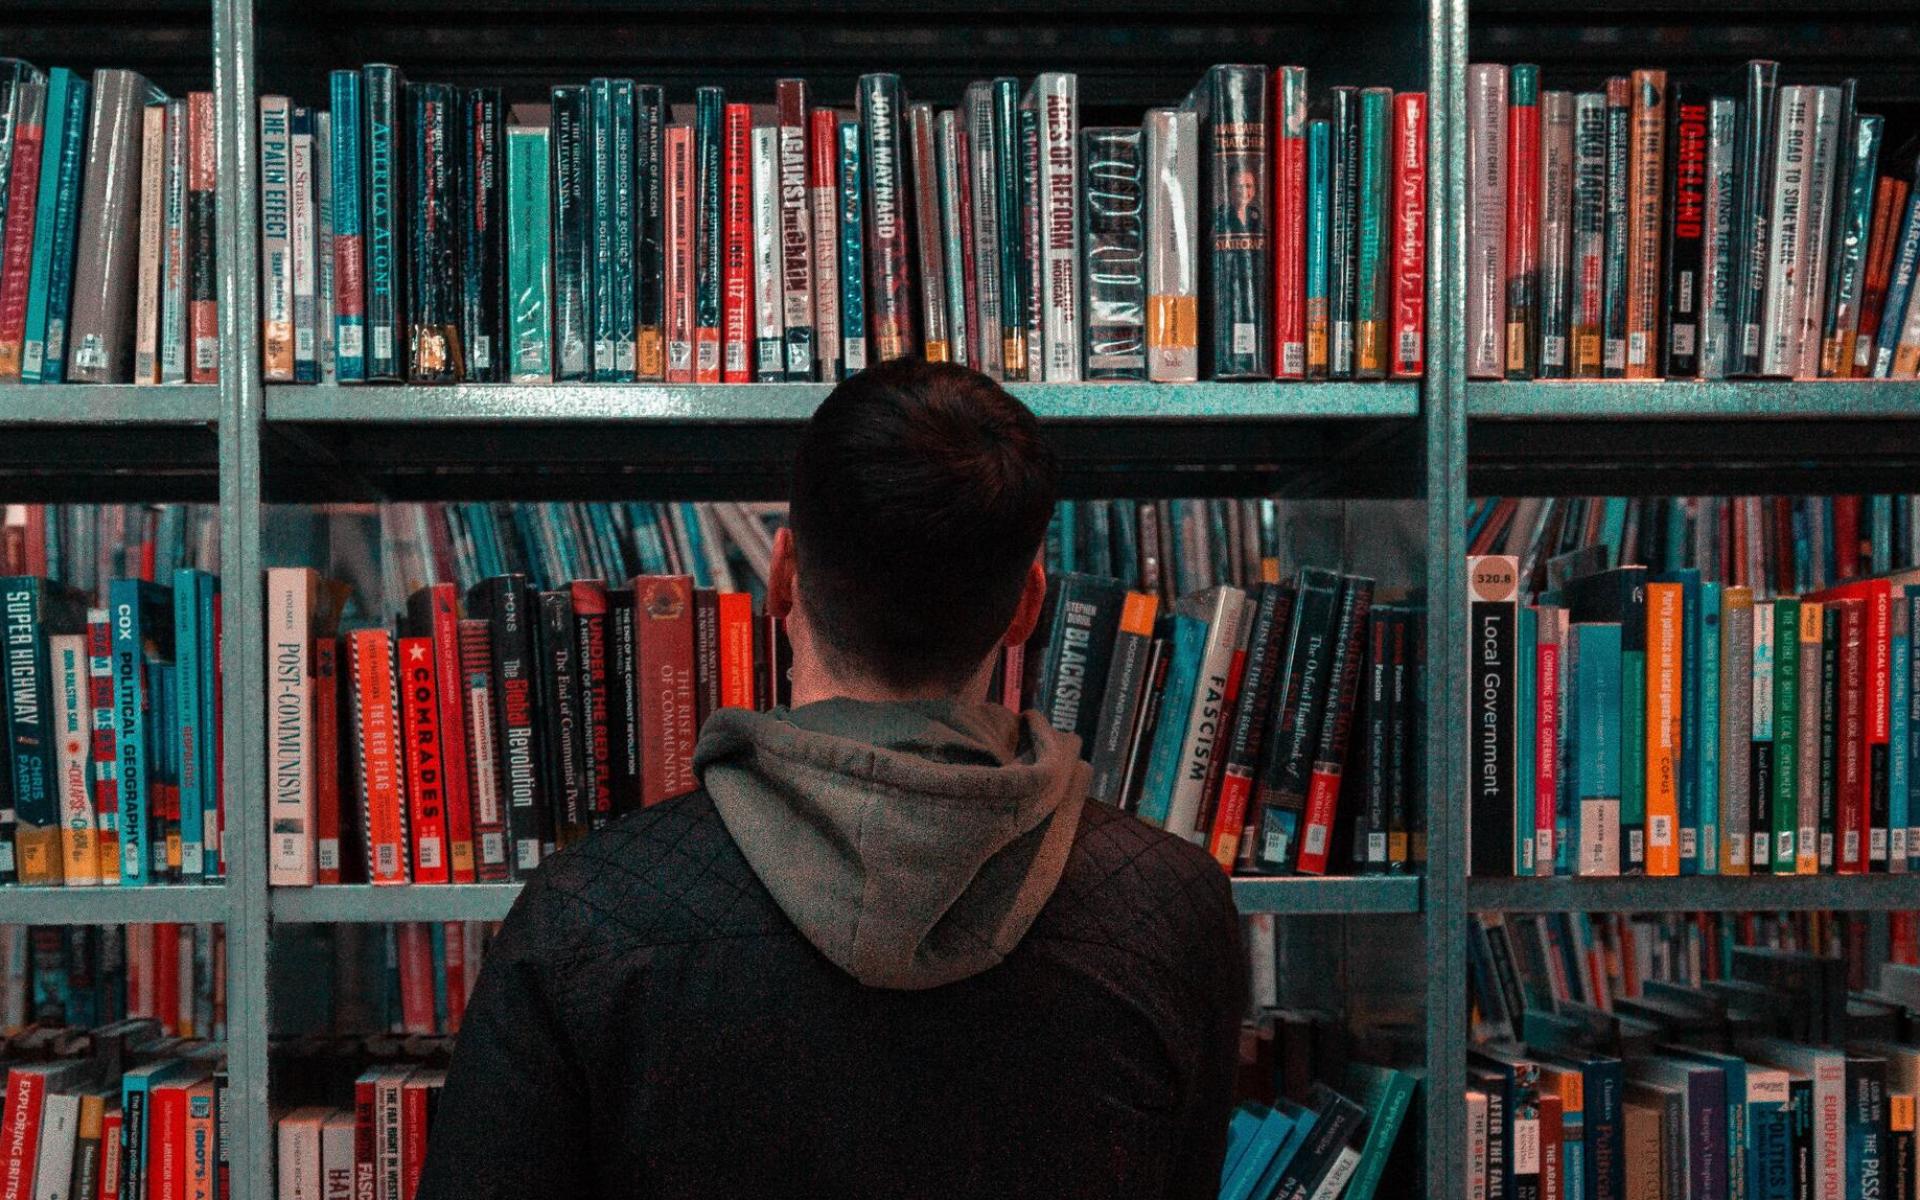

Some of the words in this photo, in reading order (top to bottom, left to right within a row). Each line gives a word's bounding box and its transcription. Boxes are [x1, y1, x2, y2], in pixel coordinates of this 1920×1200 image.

[265, 109, 284, 135] THE
[649, 105, 658, 123] THE
[871, 92, 893, 141] JOAN
[1487, 87, 1497, 129] DESCENT
[1789, 102, 1806, 123] THE
[295, 145, 305, 168] Leo
[560, 111, 571, 208] TOTALITARIANISM
[649, 125, 658, 162] NATURE
[1049, 146, 1073, 169] OF
[1348, 124, 1357, 187] Crosland
[1488, 132, 1497, 153] INTO
[1647, 132, 1659, 153] THE
[1787, 130, 1803, 162] ROAD
[265, 141, 286, 184] PALIN
[373, 120, 390, 216] AMERICA
[572, 143, 581, 183] ORIGINS
[598, 128, 607, 216] NON-DEMOCRATIC
[619, 128, 628, 216] NON-DEMOCRATIC
[650, 165, 658, 177] OF
[782, 127, 804, 210] AGAINST
[1487, 156, 1497, 187] CHAOS
[1676, 105, 1707, 239] HOMELAND
[1786, 169, 1802, 183] TO
[296, 172, 306, 218] Strauss
[573, 185, 581, 197] OF
[650, 179, 658, 217] FASCISM
[873, 146, 895, 239] MAYNARD
[1581, 164, 1604, 233] HARAM
[1718, 172, 1733, 225] SAVING
[265, 190, 287, 240] EFFECT
[1049, 173, 1074, 249] REFORM
[1780, 188, 1800, 265] SOMEWHERE
[599, 221, 608, 263] POLITICS
[620, 221, 628, 263] POLITICS
[1896, 202, 1920, 285] ANARCHISM
[374, 227, 390, 296] ALONE
[784, 232, 808, 291] GRAIN
[729, 278, 745, 298] LIZ
[1054, 259, 1063, 308] MORGAN
[1477, 574, 1511, 584] 320.8
[6, 591, 33, 645] SUPER
[285, 590, 294, 630] HOLMES
[504, 592, 517, 632] PONS
[580, 617, 588, 625] A
[1263, 592, 1276, 617] THE
[1660, 590, 1675, 616] Party
[1782, 610, 1793, 625] THE
[1877, 593, 1887, 637] SCOTTISH
[118, 604, 131, 640] COX
[1257, 620, 1271, 646] RISE
[1484, 616, 1500, 665] Local
[1661, 618, 1675, 652] politics
[555, 648, 569, 672] The
[580, 628, 590, 670] HISTORY
[589, 617, 603, 680] UNDER
[1119, 636, 1139, 691] MODERNISM
[1254, 647, 1265, 661] OF
[1308, 635, 1322, 657] The
[1782, 630, 1793, 661] NATURE
[1876, 639, 1886, 670] LOCAL
[504, 660, 520, 678] The
[582, 673, 591, 686] OF
[624, 657, 632, 672] THE
[661, 665, 673, 685] OF
[1052, 627, 1089, 733] BLACKSHIR
[1248, 666, 1261, 688] THE
[1301, 659, 1318, 699] Oxford
[1375, 664, 1385, 702] Fascism
[1782, 666, 1793, 675] OF
[11, 649, 38, 725] HIGHWAY
[120, 652, 136, 738] POLITICAL
[504, 679, 531, 726] Global
[557, 675, 571, 699] End
[677, 670, 689, 699] THE
[1114, 692, 1128, 714] AND
[1243, 692, 1256, 713] FAR
[1327, 687, 1340, 708] FAR
[370, 704, 386, 726] THE
[559, 703, 573, 716] of
[582, 689, 594, 754] COMMUNISM
[592, 688, 606, 720] THE
[678, 704, 690, 735] RISE
[1543, 700, 1554, 725] LOCAL
[1660, 692, 1675, 748] government
[1875, 672, 1885, 738] GOVERNMENT
[277, 642, 301, 805] POST-COMMUNISM
[661, 690, 676, 793] COMMUNISM
[1107, 714, 1124, 753] FASCISM
[1190, 677, 1226, 781] FASCISM
[1235, 715, 1251, 753] RIGHT
[1289, 702, 1312, 759] Handbook
[1320, 712, 1336, 751] RIGHT
[1483, 673, 1500, 796] Government
[1781, 715, 1793, 739] LOCAL
[372, 732, 388, 756] RED
[414, 667, 440, 820] COMRADES
[559, 717, 576, 787] Communist
[594, 726, 608, 760] RED
[679, 740, 691, 752] &
[17, 754, 33, 802] PARRY
[30, 756, 44, 800] CHRIS
[374, 760, 389, 791] FLAG
[508, 727, 534, 807] Revolution
[586, 757, 595, 767] IN
[680, 757, 692, 786] FALL
[1286, 762, 1300, 778] of
[1661, 757, 1671, 795] COPUS
[1780, 744, 1792, 798] GOVERNMENT
[123, 745, 139, 845] GEOGRAPHY
[595, 764, 610, 811] FLAG
[564, 789, 579, 825] Power
[132, 1095, 140, 1108] the
[387, 1088, 396, 1104] THE
[11, 1080, 32, 1156] EXPLORING
[131, 1111, 140, 1148] American
[387, 1107, 397, 1124] FAR
[1475, 1114, 1484, 1135] THE
[1490, 1095, 1503, 1135] AFTER
[1701, 1107, 1713, 1150] Europe's
[1824, 1095, 1837, 1168] EUROPEAN
[194, 1129, 206, 1177] IDIOT'S
[388, 1127, 397, 1154] RIGHT
[1474, 1139, 1483, 1174] GREAT
[1490, 1140, 1502, 1163] THE
[1547, 1143, 1556, 1163] THE
[1769, 1111, 1786, 1186] POLITICS
[1865, 1133, 1877, 1154] THE
[4, 1158, 22, 1200] BRITIS
[129, 1149, 138, 1181] political
[163, 1142, 173, 1180] AMERICAN
[388, 1158, 397, 1167] IN
[1547, 1166, 1556, 1193] ARAB
[358, 1163, 373, 1200] FASC
[1490, 1169, 1502, 1198] FALL
